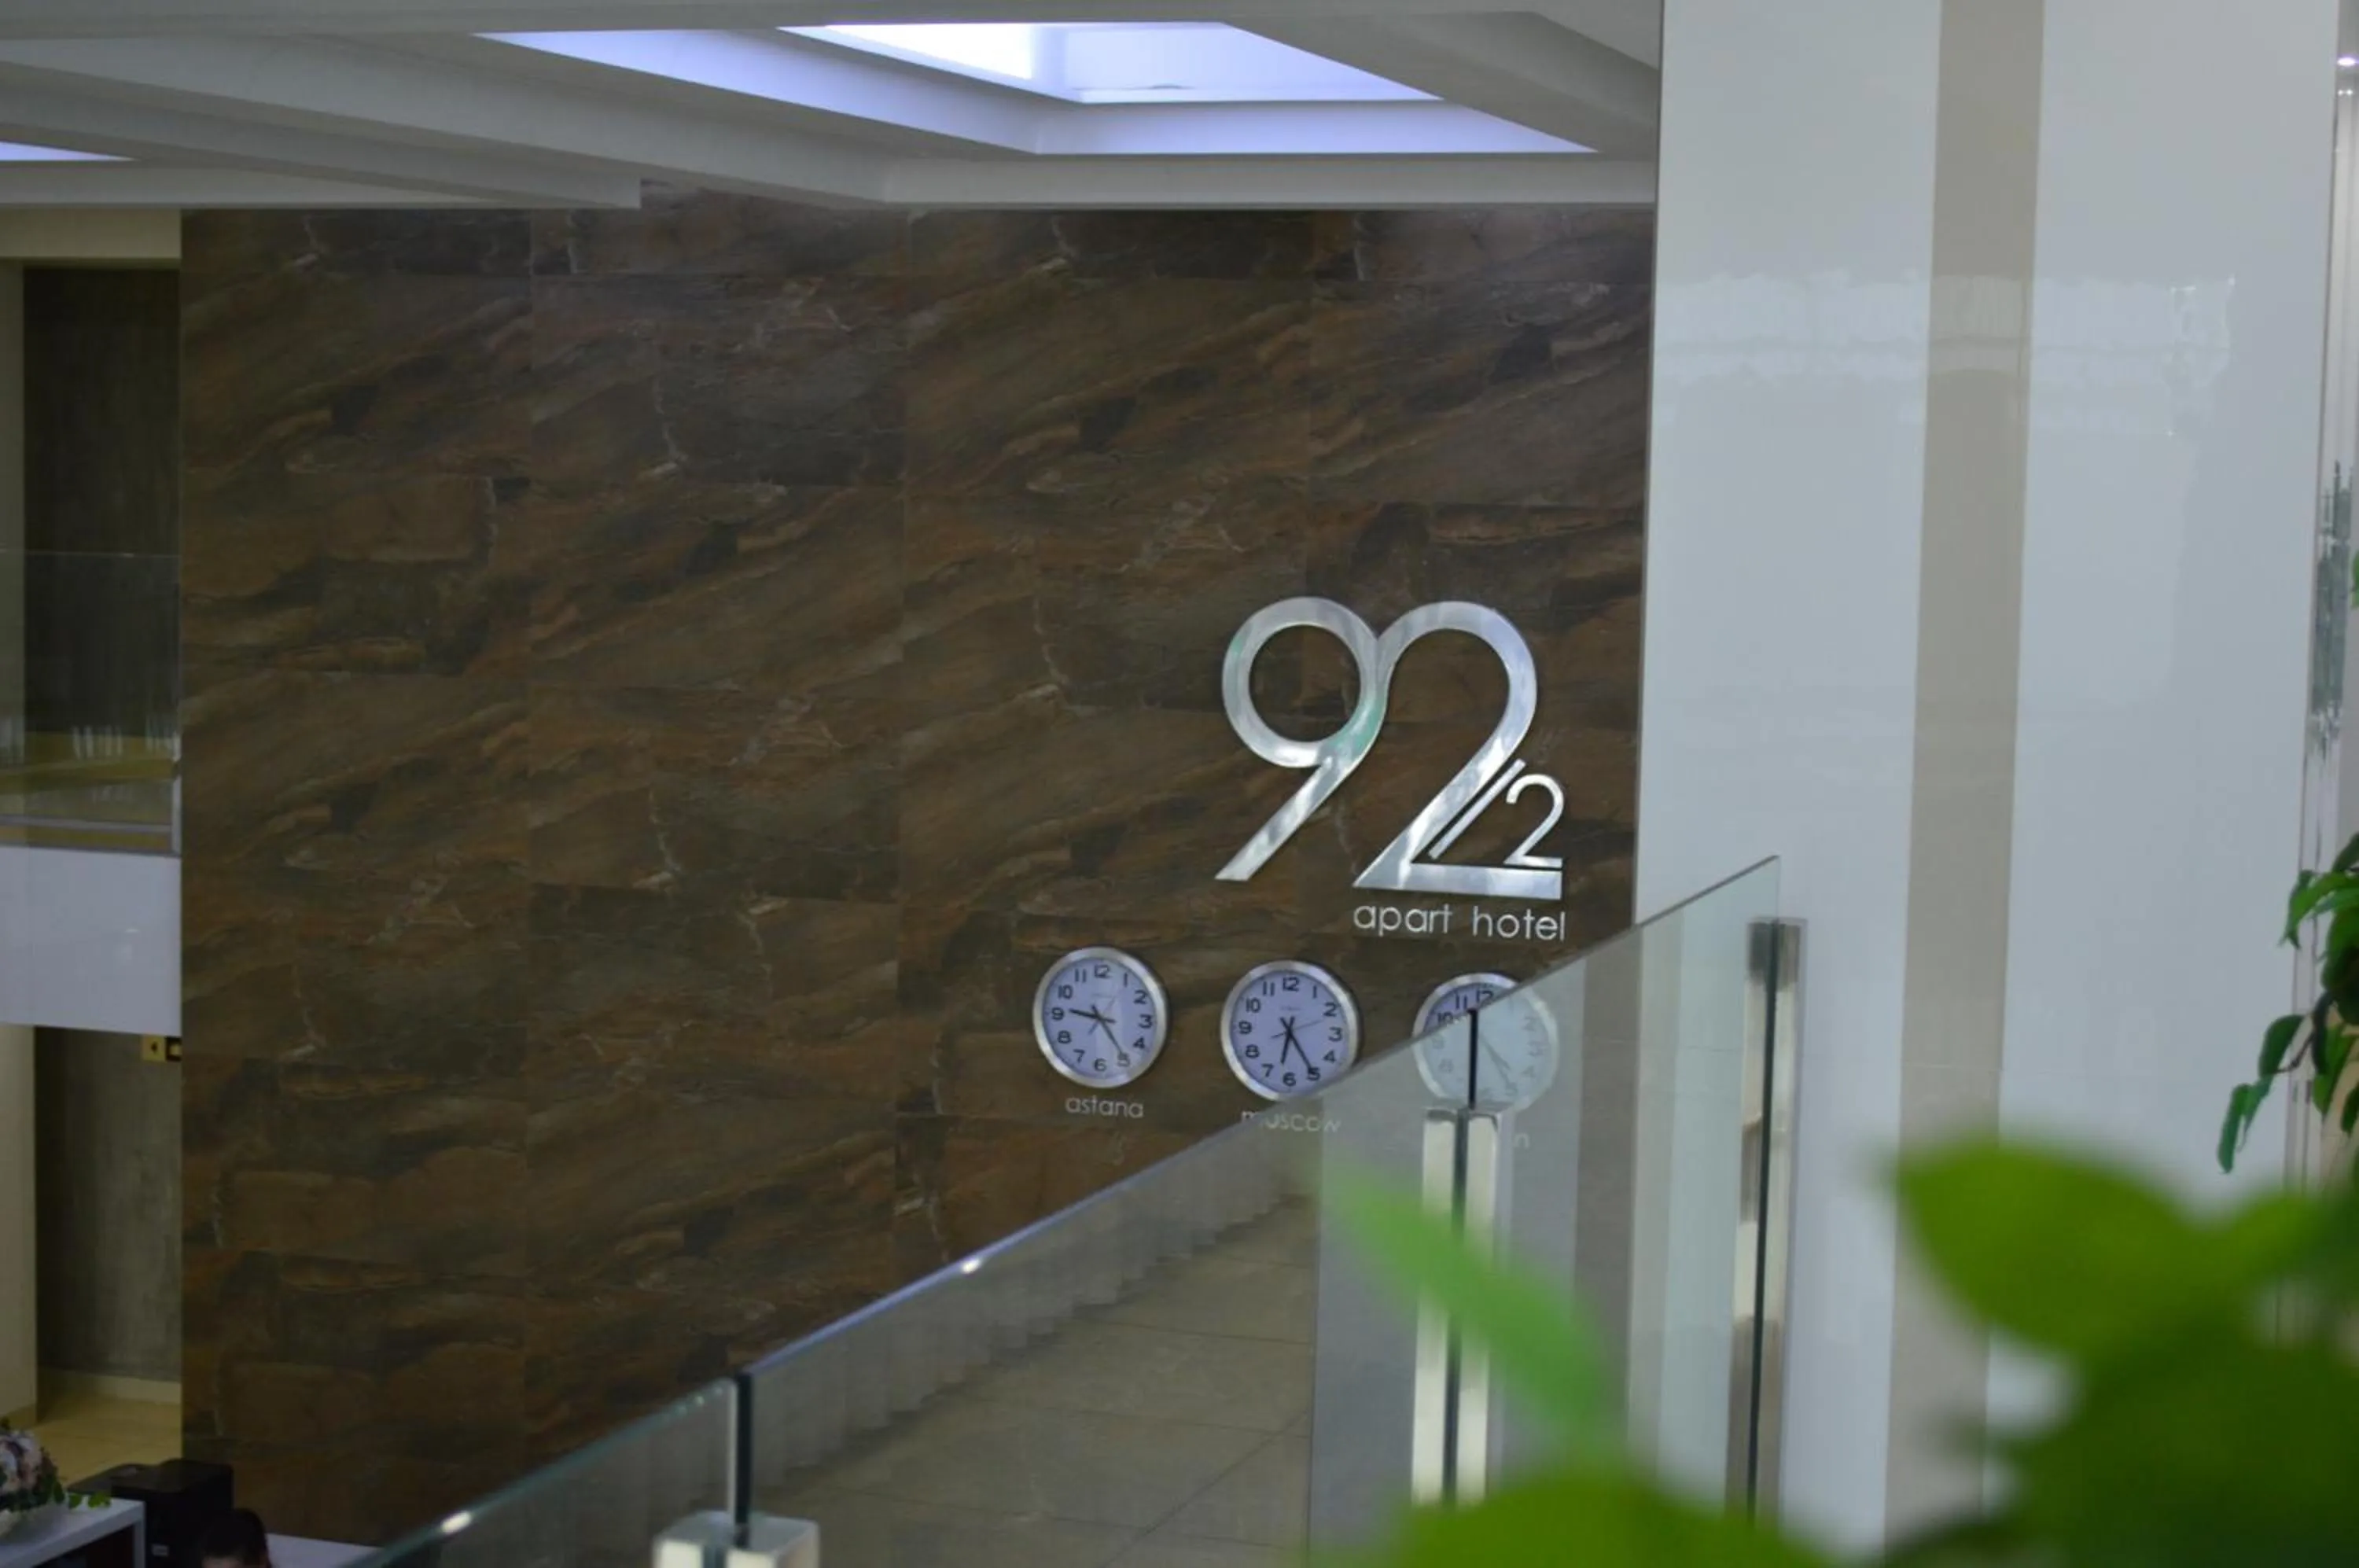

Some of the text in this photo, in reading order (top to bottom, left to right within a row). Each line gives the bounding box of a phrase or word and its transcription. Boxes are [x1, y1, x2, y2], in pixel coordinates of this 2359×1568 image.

[1352, 904, 1566, 941] apart hotel
[1074, 969, 1087, 983] 11
[1094, 964, 1110, 979] 12
[1123, 973, 1128, 986] 1
[1283, 977, 1299, 992] 12
[1058, 985, 1073, 999] 10
[1262, 981, 1274, 996] 11
[1312, 985, 1317, 999] 1
[1134, 990, 1147, 1004] 2
[1456, 994, 1467, 1009] 11
[1246, 998, 1261, 1013] 10
[1323, 1002, 1336, 1017] 2
[1051, 1007, 1064, 1020] 9
[1139, 1014, 1152, 1029] 3
[1238, 1021, 1252, 1034] 9
[1057, 1031, 1072, 1043] 8
[1329, 1027, 1341, 1042] 3
[1133, 1038, 1146, 1049] 4
[1073, 1049, 1085, 1062] 7
[1245, 1044, 1260, 1058] 8
[1323, 1051, 1335, 1063] 4
[1094, 1058, 1107, 1072] 6
[1262, 1064, 1274, 1077] 7
[1283, 1072, 1296, 1086] 6
[1065, 1095, 1144, 1118] astana
